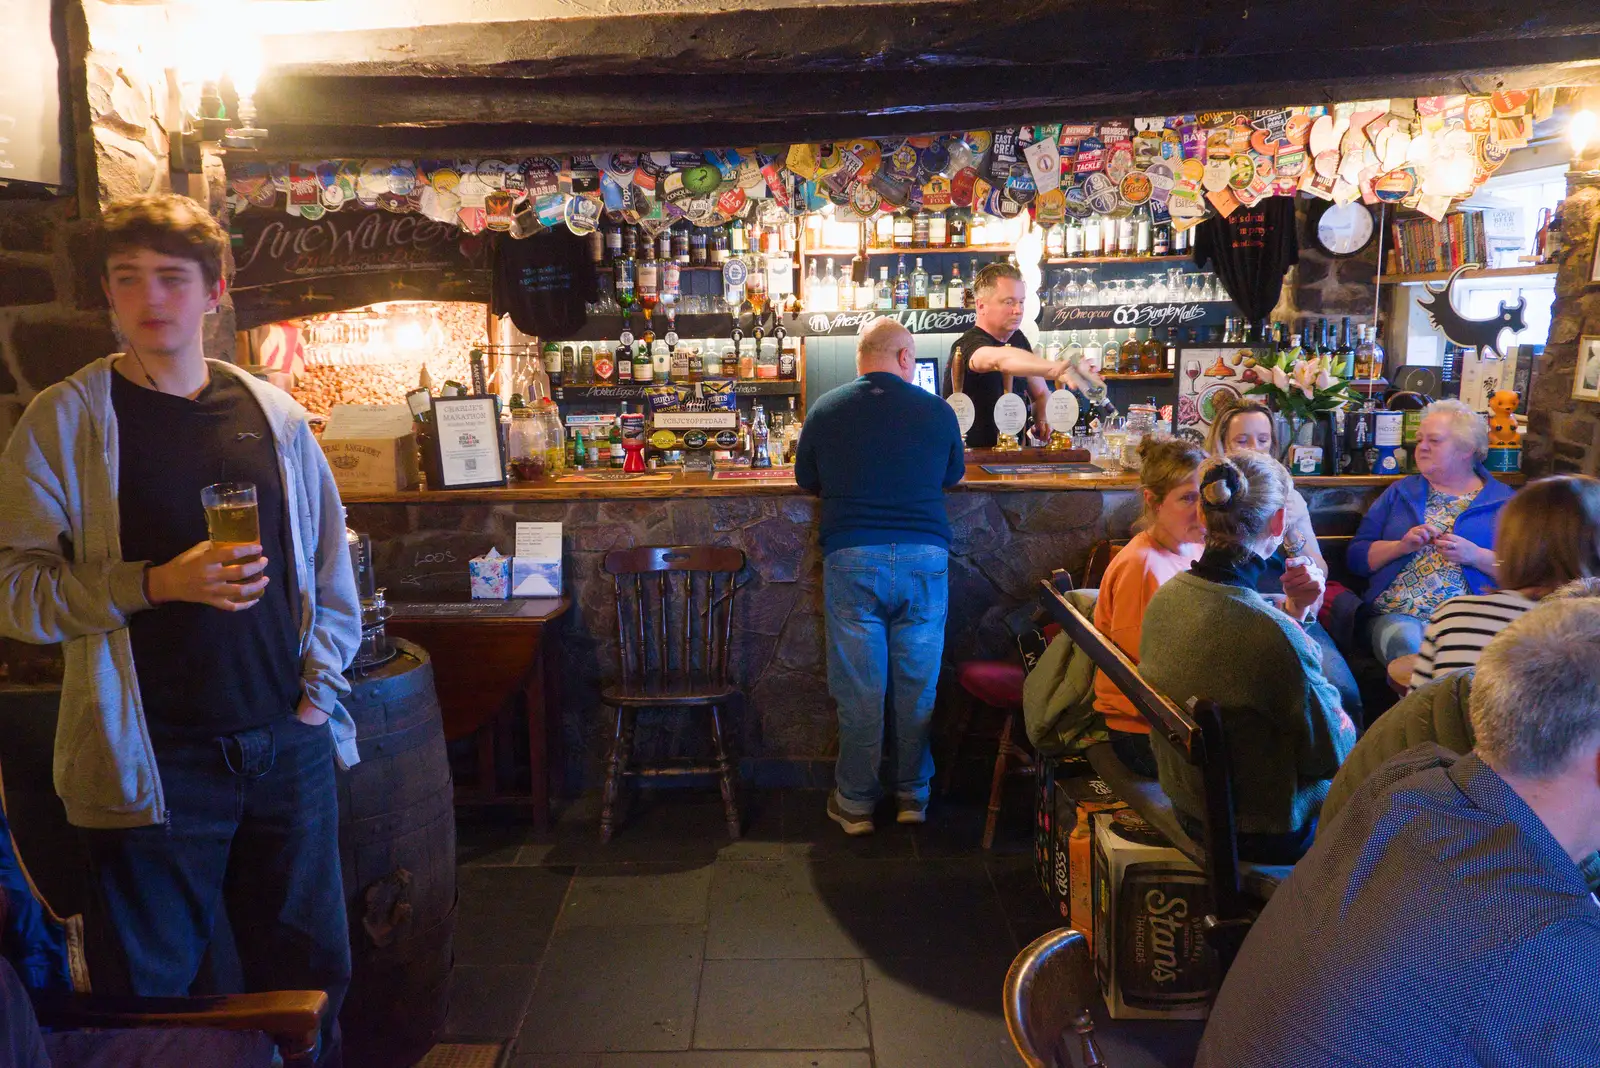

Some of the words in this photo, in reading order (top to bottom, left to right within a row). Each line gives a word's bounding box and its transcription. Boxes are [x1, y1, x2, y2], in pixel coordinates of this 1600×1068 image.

[995, 134, 1012, 145] EAST
[1183, 132, 1207, 144] BAYS
[993, 143, 1016, 155] CREA
[1076, 161, 1101, 172] TACKLE
[529, 187, 543, 197] OLD
[543, 184, 558, 194] SLUG
[1052, 309, 1075, 327] Try
[1075, 309, 1090, 320] One
[1113, 305, 1139, 325] 63
[1137, 306, 1173, 326] Single
[1169, 305, 1206, 323] Malts
[615, 387, 634, 399] Eggs
[443, 404, 484, 413] CHARLIE'S
[442, 412, 487, 421] MARATHON
[413, 551, 458, 567] LOOS
[1136, 914, 1146, 964] THATCHERS
[1145, 889, 1189, 984] Stan's
